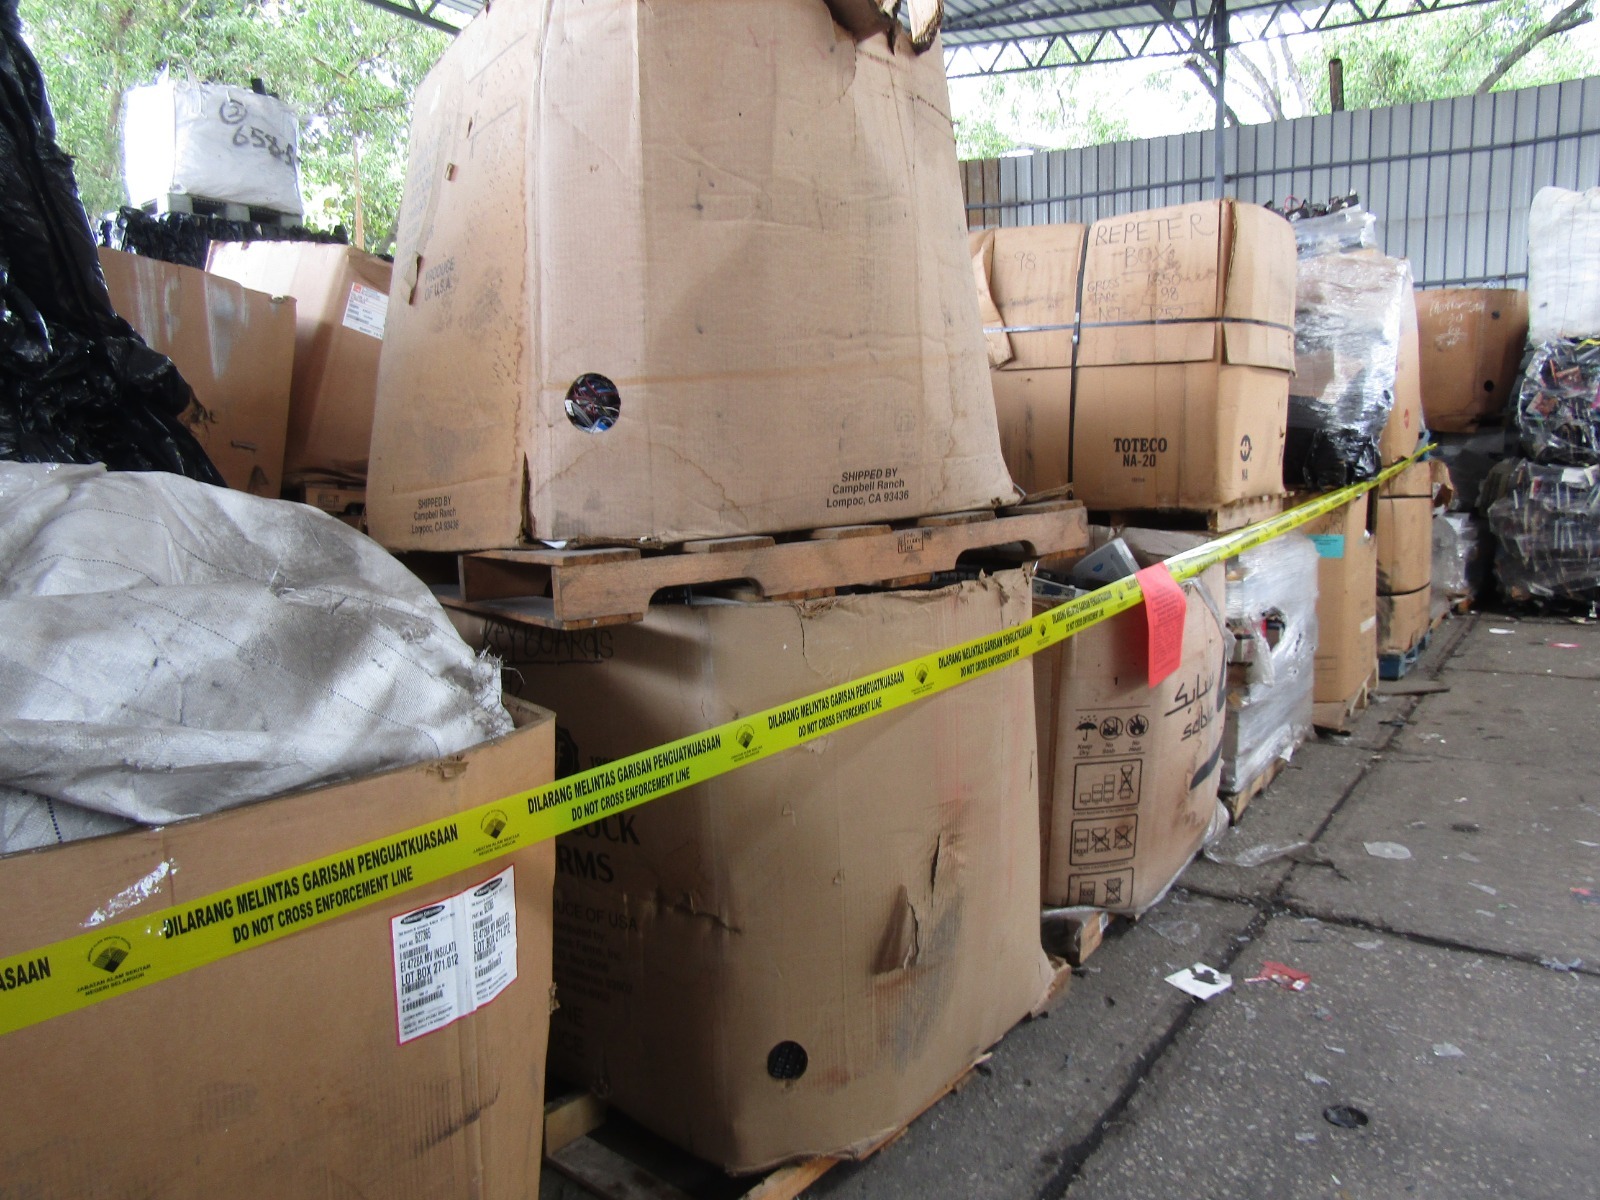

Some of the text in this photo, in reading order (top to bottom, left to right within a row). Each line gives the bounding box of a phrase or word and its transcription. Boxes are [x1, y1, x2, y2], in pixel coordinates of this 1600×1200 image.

[1095, 213, 1215, 246] REPETER
[1160, 286, 1179, 302] 98
[1113, 437, 1168, 453] TOTECO
[1122, 453, 1156, 468] NA-20
[841, 467, 898, 482] SHIPPED BY
[832, 478, 905, 495] Campbell Ranch
[417, 495, 452, 510] SHIPPED BY
[826, 490, 909, 509] Lompoc, CA 93436
[413, 507, 457, 522] Campbell Ranch
[434, 521, 443, 533] CA
[768, 710, 800, 730] DILARANG
[800, 698, 830, 718] MELINTAS
[830, 688, 856, 707] GARISAN
[855, 670, 905, 698] PENGUATKUASAAN
[798, 697, 883, 738] DO NOT CROSS ENFORCEMENT LINE
[527, 785, 573, 815] DILARANG
[574, 770, 616, 798] MELINTAS
[617, 757, 652, 783] GARISAN
[653, 734, 722, 772] PENGUATKUASAAN
[571, 766, 691, 823] DO NOT CROSS ENFORCEMENT LINE
[164, 823, 458, 940] DILARANG MELINTAS GARISAN PENGUATKUASAAN
[232, 866, 414, 944] DO NOT CROSS ENFORCEMENT LINE
[586, 906, 605, 924] OF
[608, 911, 638, 932] USA
[433, 953, 459, 974] 271.012
[76, 979, 106, 993] JABATAN
[106, 972, 124, 983] ALAM
